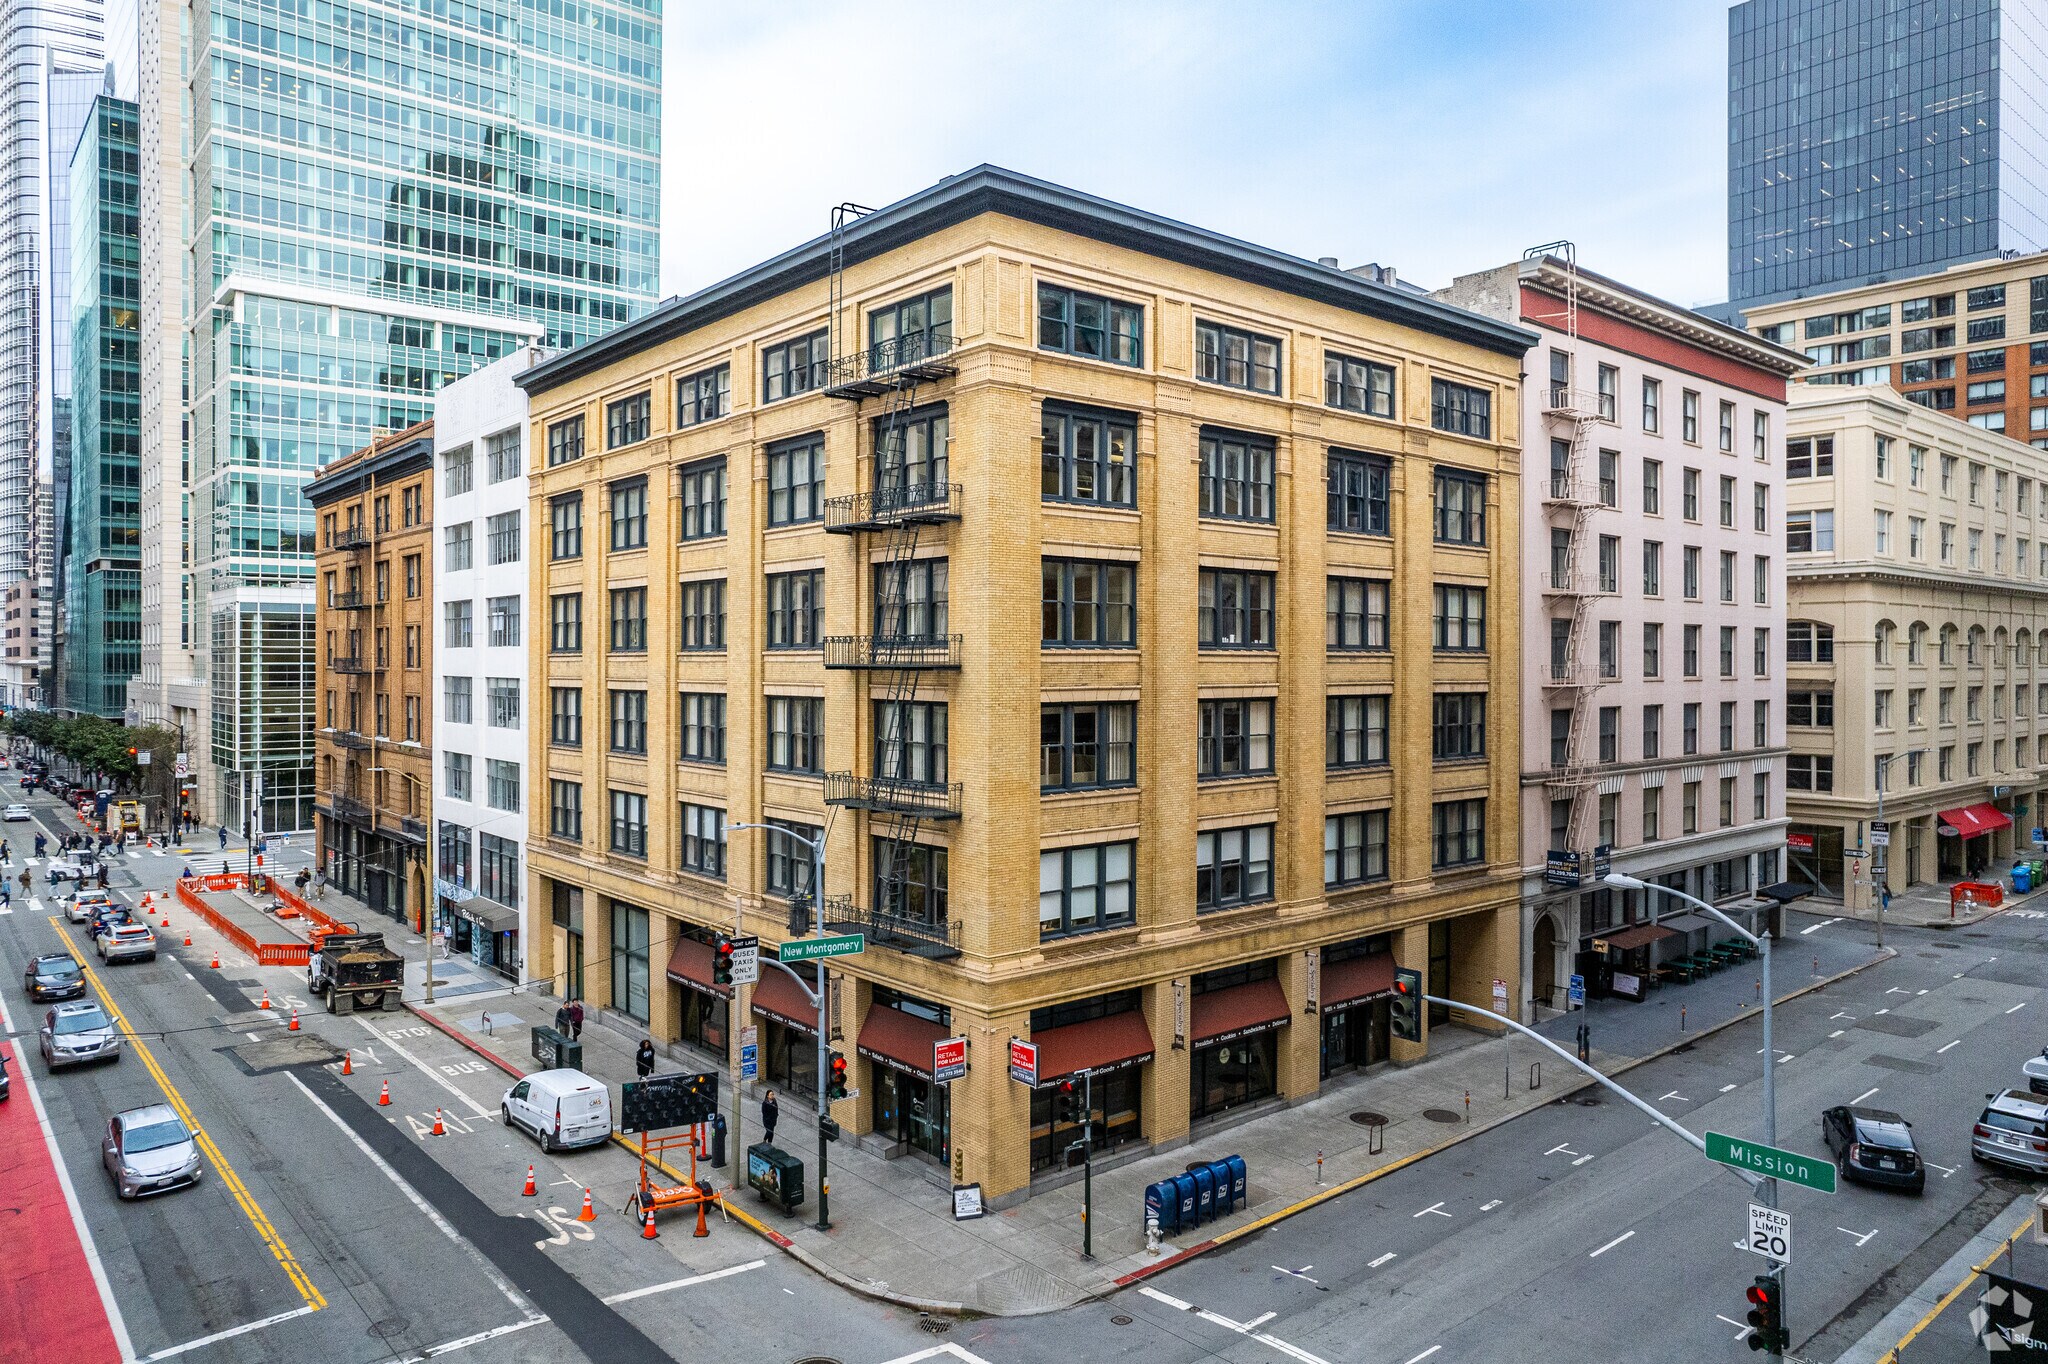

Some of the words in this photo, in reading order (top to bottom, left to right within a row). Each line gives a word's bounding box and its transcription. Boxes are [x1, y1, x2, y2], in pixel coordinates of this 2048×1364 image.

[732, 949, 756, 959] BUSES
[784, 947, 803, 957] New
[805, 941, 860, 955] Montgomery
[734, 957, 754, 967] TAXIS
[734, 966, 753, 975] ONLY
[386, 1026, 432, 1039] STOP
[1220, 1032, 1237, 1041] Cookies
[1243, 1025, 1266, 1035] Sandwiches
[937, 1051, 957, 1060] RETAIL
[949, 1055, 964, 1063] LEASE
[1012, 1051, 1028, 1062] RETAIL
[440, 1061, 489, 1076] BUS
[888, 1058, 906, 1070] Espresso
[916, 1070, 930, 1080] Online
[1021, 1060, 1034, 1069] LEASE
[1100, 1065, 1115, 1075] Goods
[1730, 1144, 1808, 1179] Mission
[1752, 1209, 1788, 1226] SPEED
[1755, 1220, 1784, 1235] LIMIT
[1753, 1231, 1787, 1256] 20
